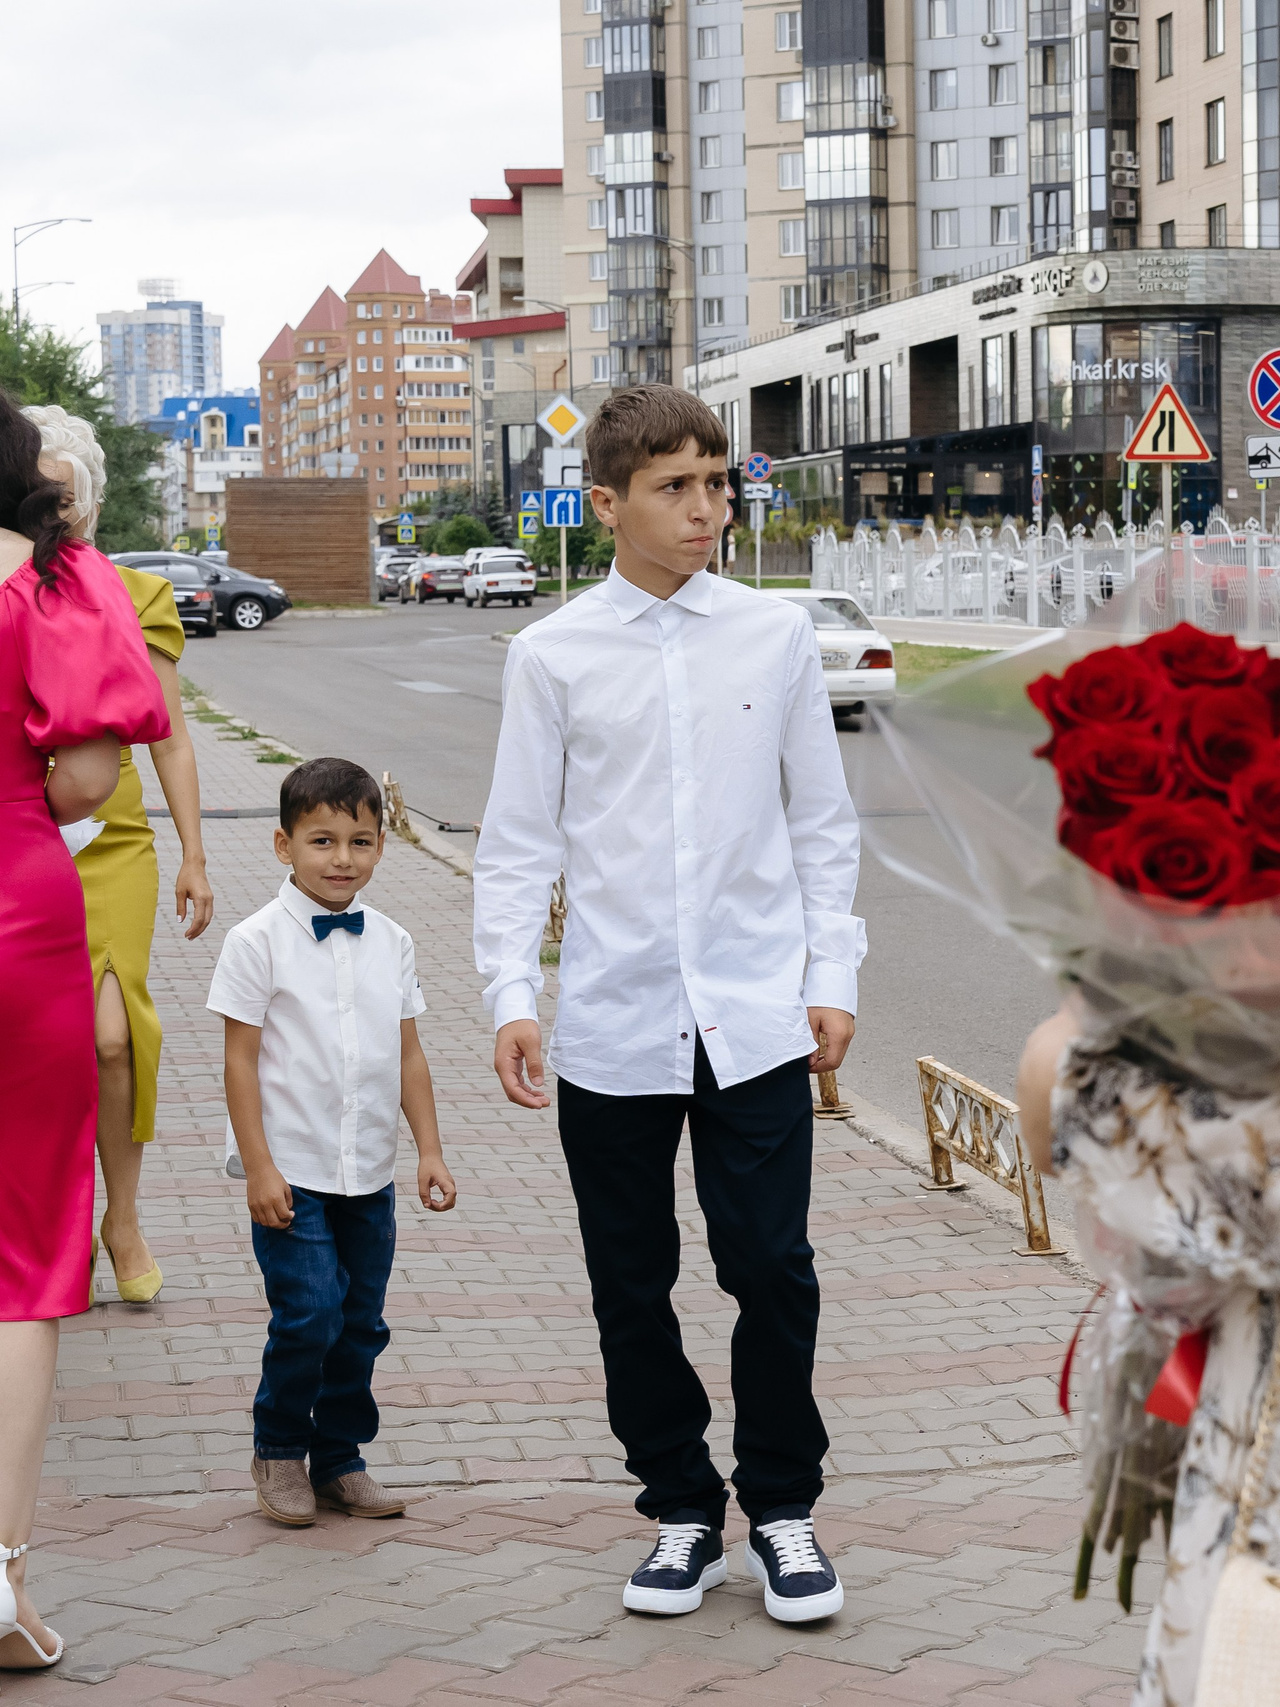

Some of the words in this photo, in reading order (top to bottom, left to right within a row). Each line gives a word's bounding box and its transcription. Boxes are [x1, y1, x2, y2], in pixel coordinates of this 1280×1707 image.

[1136, 256, 1190, 267] МАГАЗИН
[1136, 268, 1192, 279] ЖЕНСКОЙ
[1028, 265, 1075, 297] SHKAF
[1137, 281, 1188, 293] ОДЕЖДЫ
